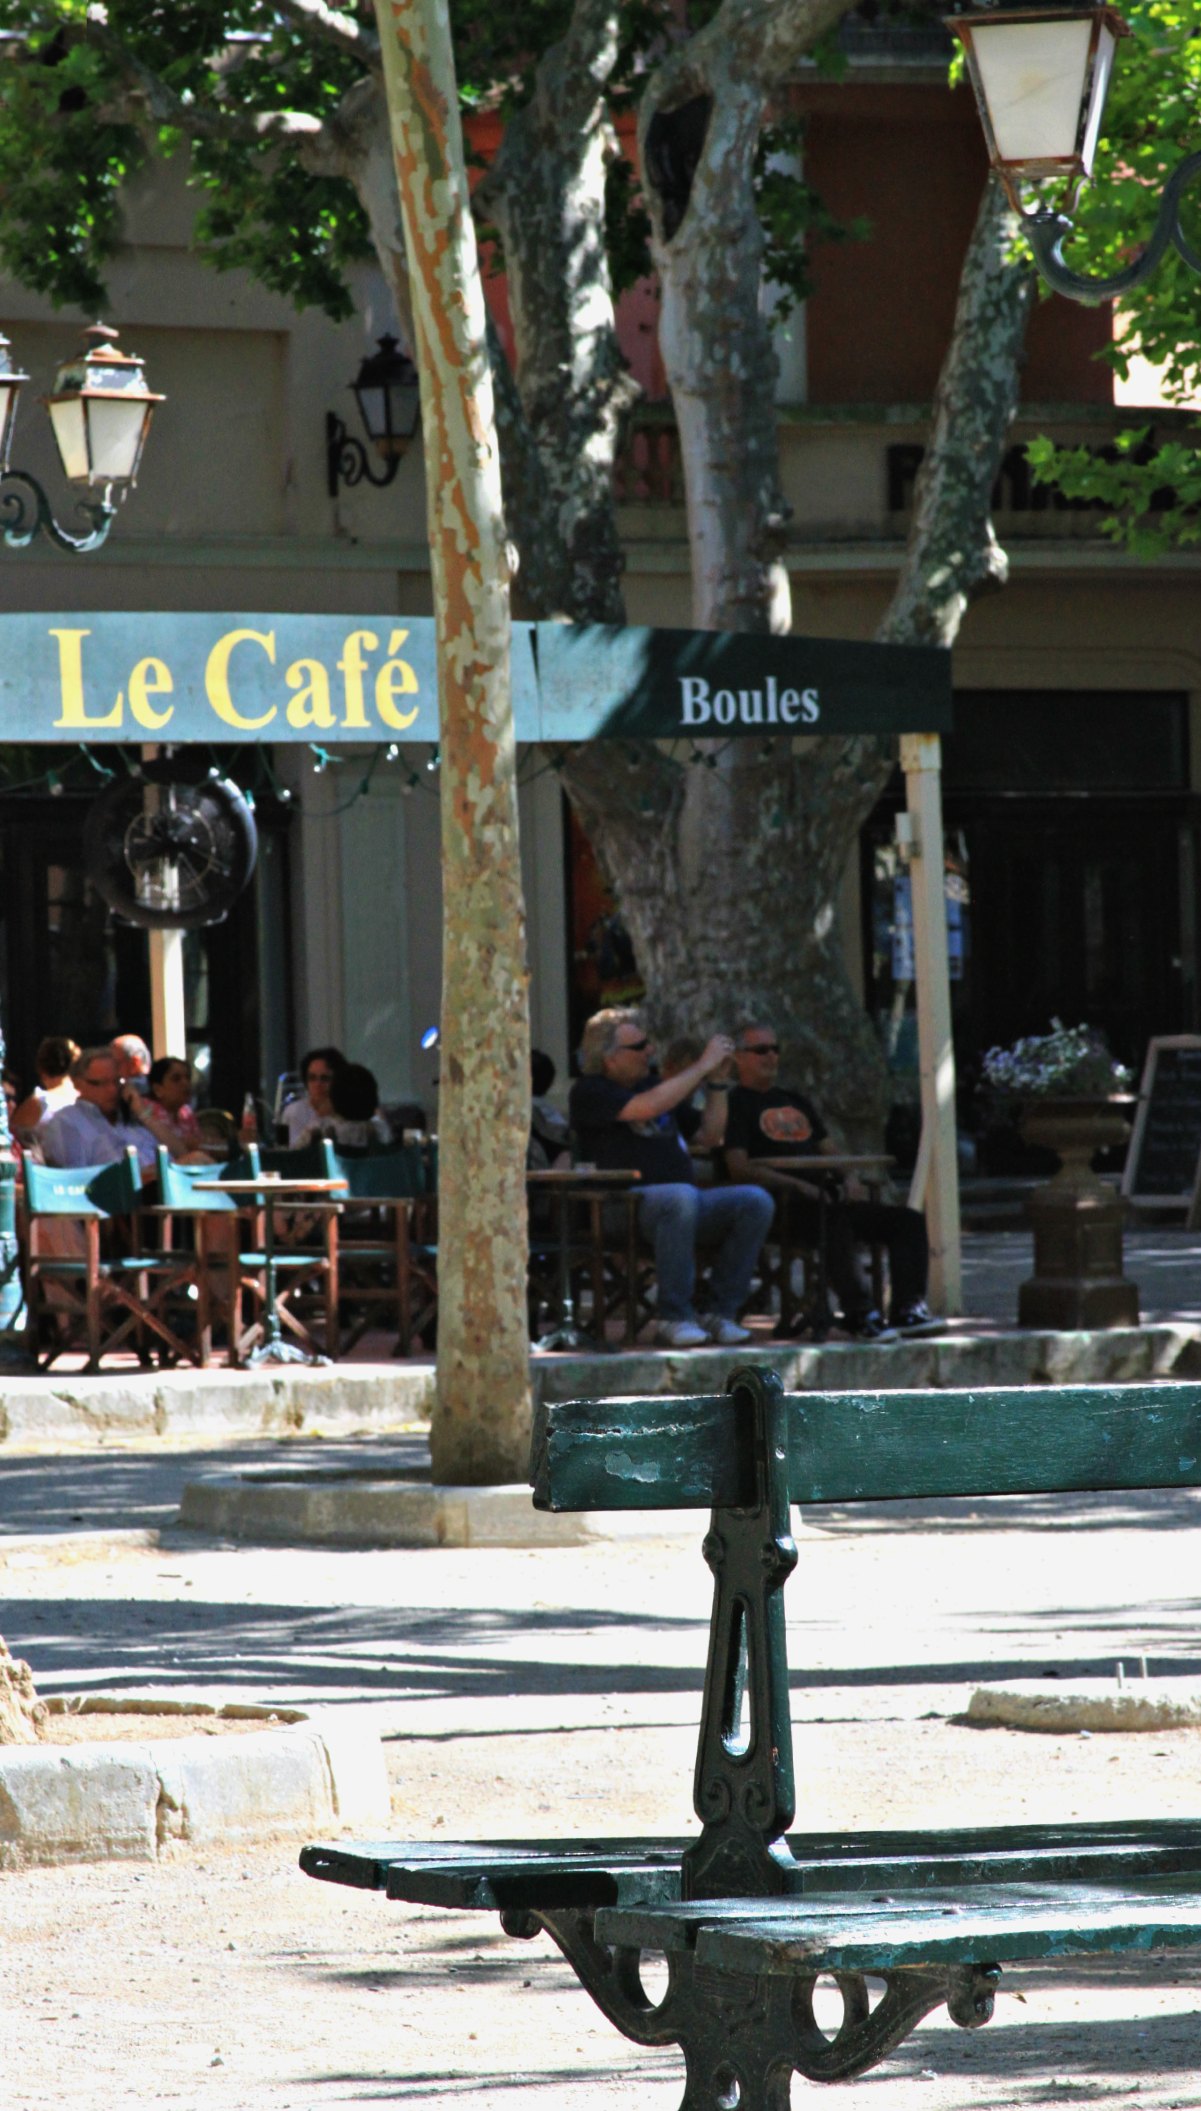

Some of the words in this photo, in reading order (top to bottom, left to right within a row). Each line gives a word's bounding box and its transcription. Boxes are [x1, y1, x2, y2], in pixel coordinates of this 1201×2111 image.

[49, 628, 174, 729] Le
[205, 628, 419, 730] Café
[679, 676, 820, 725] Boules
